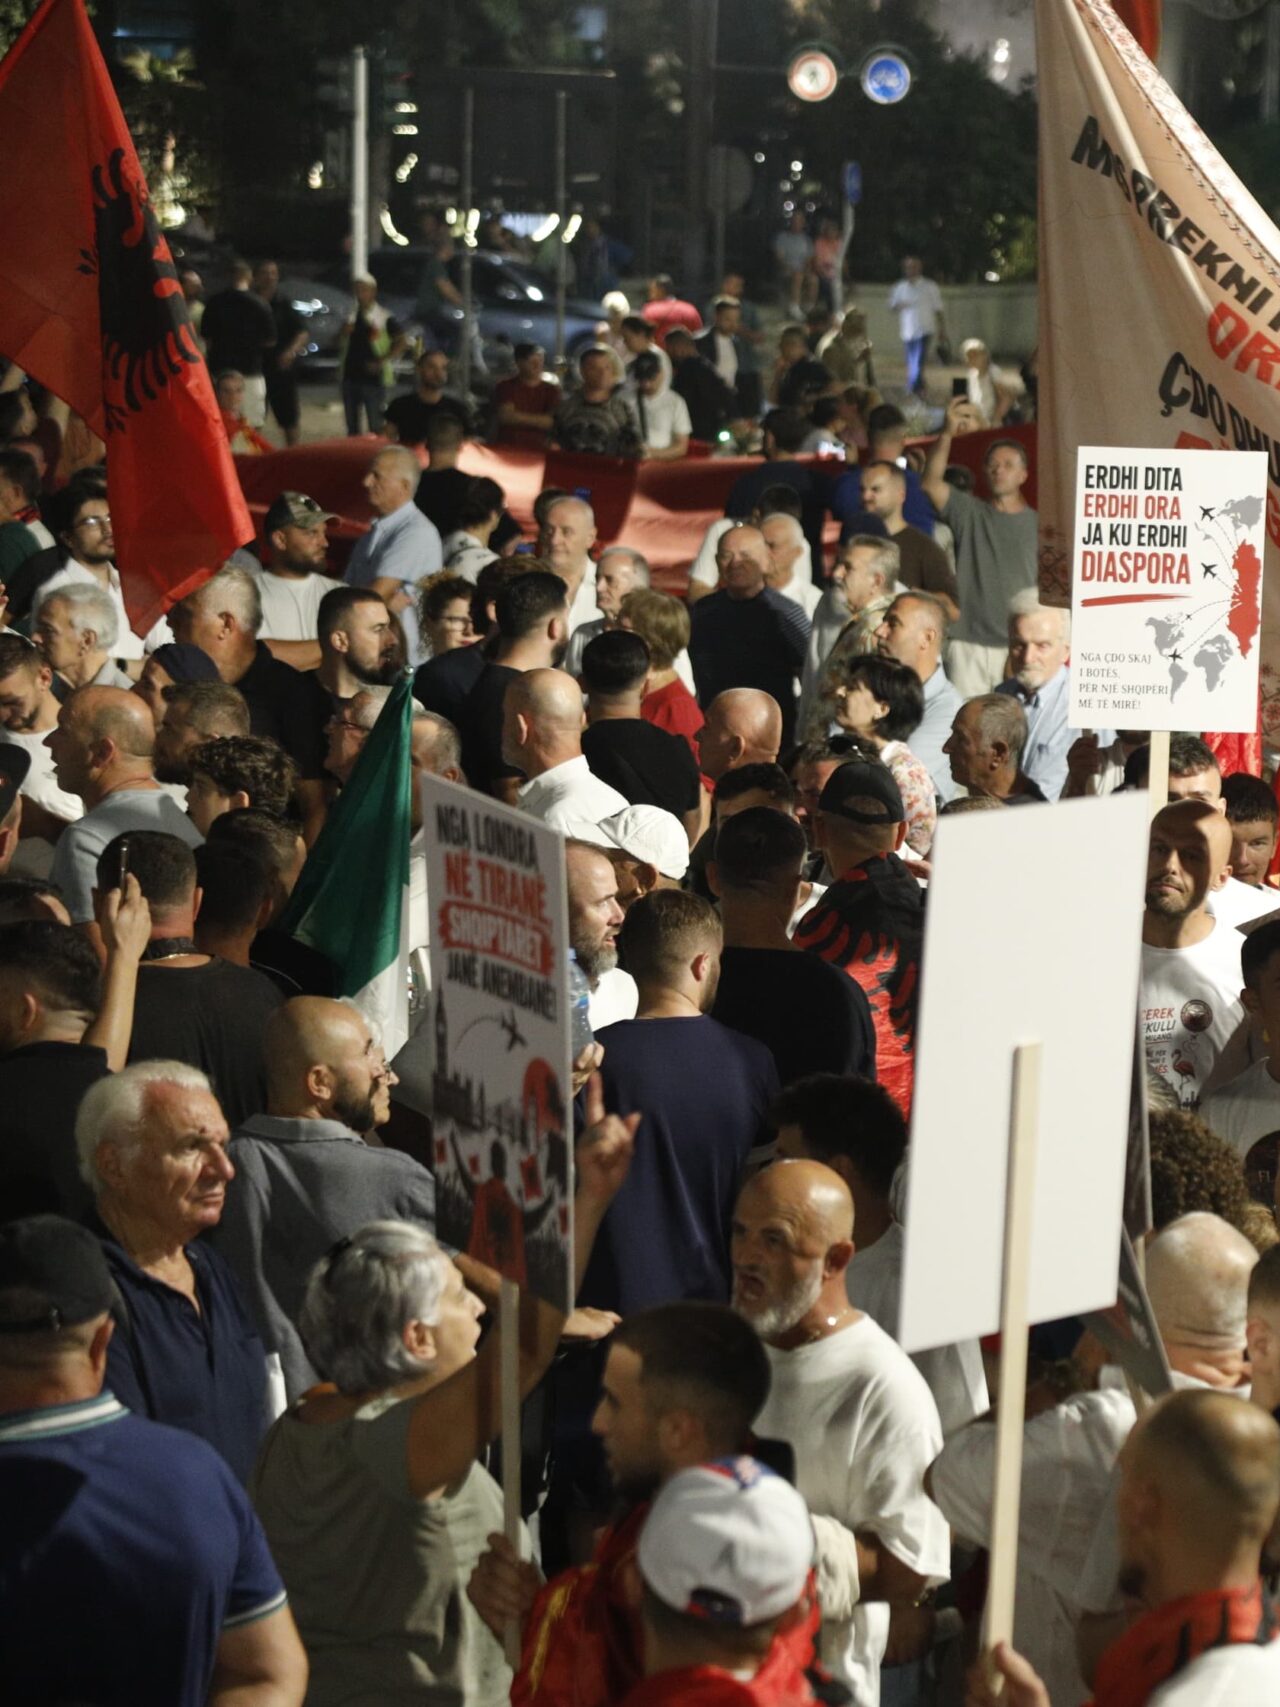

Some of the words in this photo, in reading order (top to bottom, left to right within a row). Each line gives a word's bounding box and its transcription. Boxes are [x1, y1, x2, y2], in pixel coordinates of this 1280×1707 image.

[1071, 115, 1131, 203] MS
[1159, 352, 1228, 437] ÇDO
[1084, 464, 1138, 490] ERDHI
[1144, 467, 1183, 491] DITA
[1083, 493, 1137, 519] ERDHI
[1144, 494, 1181, 520] ORA
[1082, 522, 1103, 546] JA
[1109, 523, 1132, 547] KU
[1137, 524, 1187, 548] ERDHI
[1081, 550, 1191, 584] DIASPORA
[1080, 652, 1101, 662] NGA
[1104, 653, 1126, 664] ÇDO
[1128, 653, 1152, 665] SKAJ
[436, 804, 471, 848] NGA
[474, 812, 540, 871] LONDRA
[1142, 1008, 1175, 1020] EREK
[1143, 1019, 1176, 1033] KULLI
